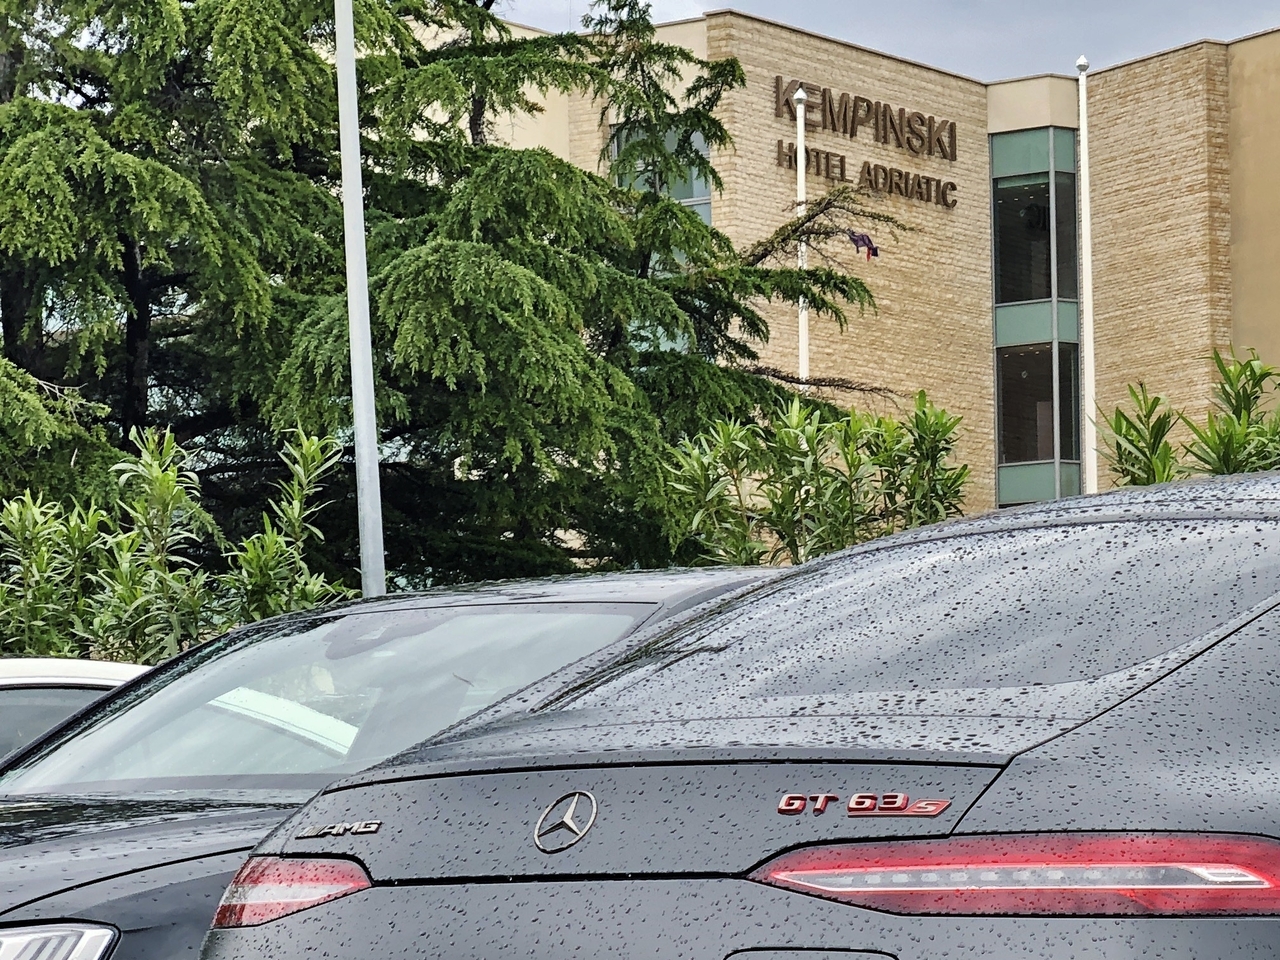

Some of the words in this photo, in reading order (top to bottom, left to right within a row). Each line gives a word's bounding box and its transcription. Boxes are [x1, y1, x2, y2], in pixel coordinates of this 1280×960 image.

[774, 75, 957, 162] KEMPINSKI
[858, 160, 958, 209] ADRIATIC
[778, 793, 839, 815] GT
